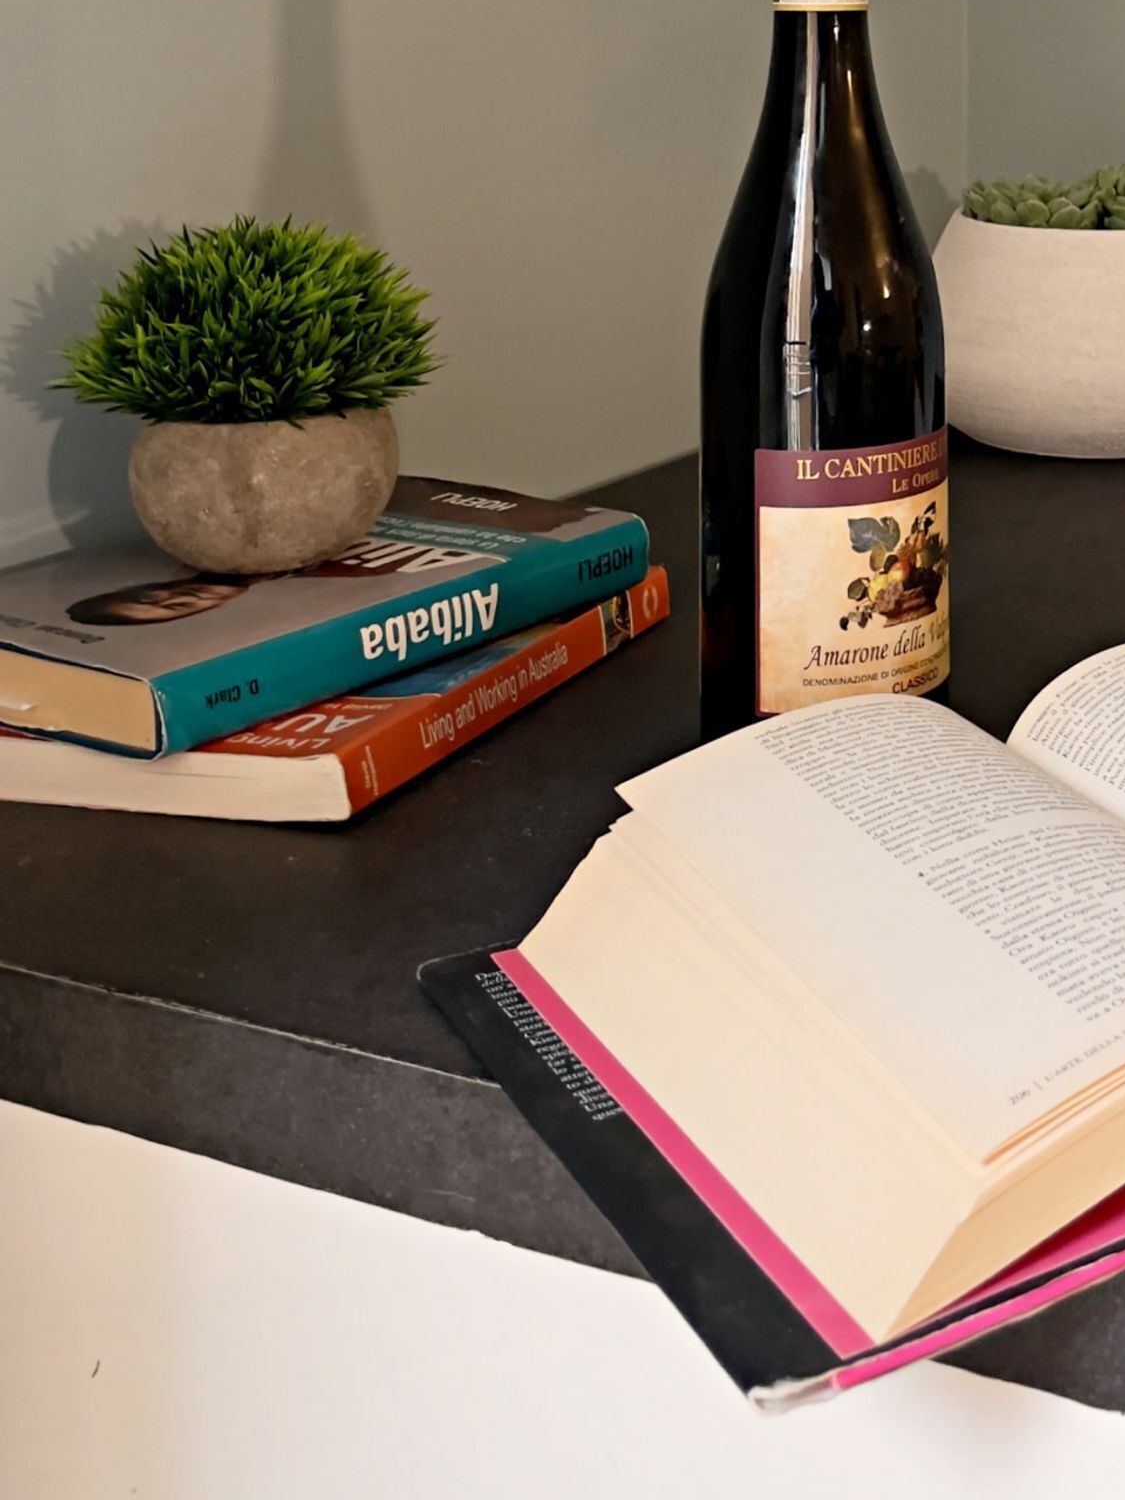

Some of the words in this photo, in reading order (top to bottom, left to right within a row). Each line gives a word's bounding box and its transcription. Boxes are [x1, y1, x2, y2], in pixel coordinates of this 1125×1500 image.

[797, 459, 819, 480] IL
[824, 441, 938, 479] CANTINIERE
[431, 492, 518, 511] HOEPLI
[577, 545, 634, 583] HOEPLI
[360, 582, 499, 661] Alibaba
[803, 643, 889, 670] Amarone
[893, 624, 926, 657] della
[246, 678, 259, 696] D.
[802, 673, 879, 687] DENOMINAZIONE
[881, 670, 890, 679] DI
[892, 666, 939, 694] CLASSICO
[204, 685, 242, 709] Clark
[418, 709, 455, 750] Living
[455, 693, 476, 729] and
[475, 675, 518, 716] Working
[516, 665, 526, 690] in
[528, 641, 569, 684] Australia
